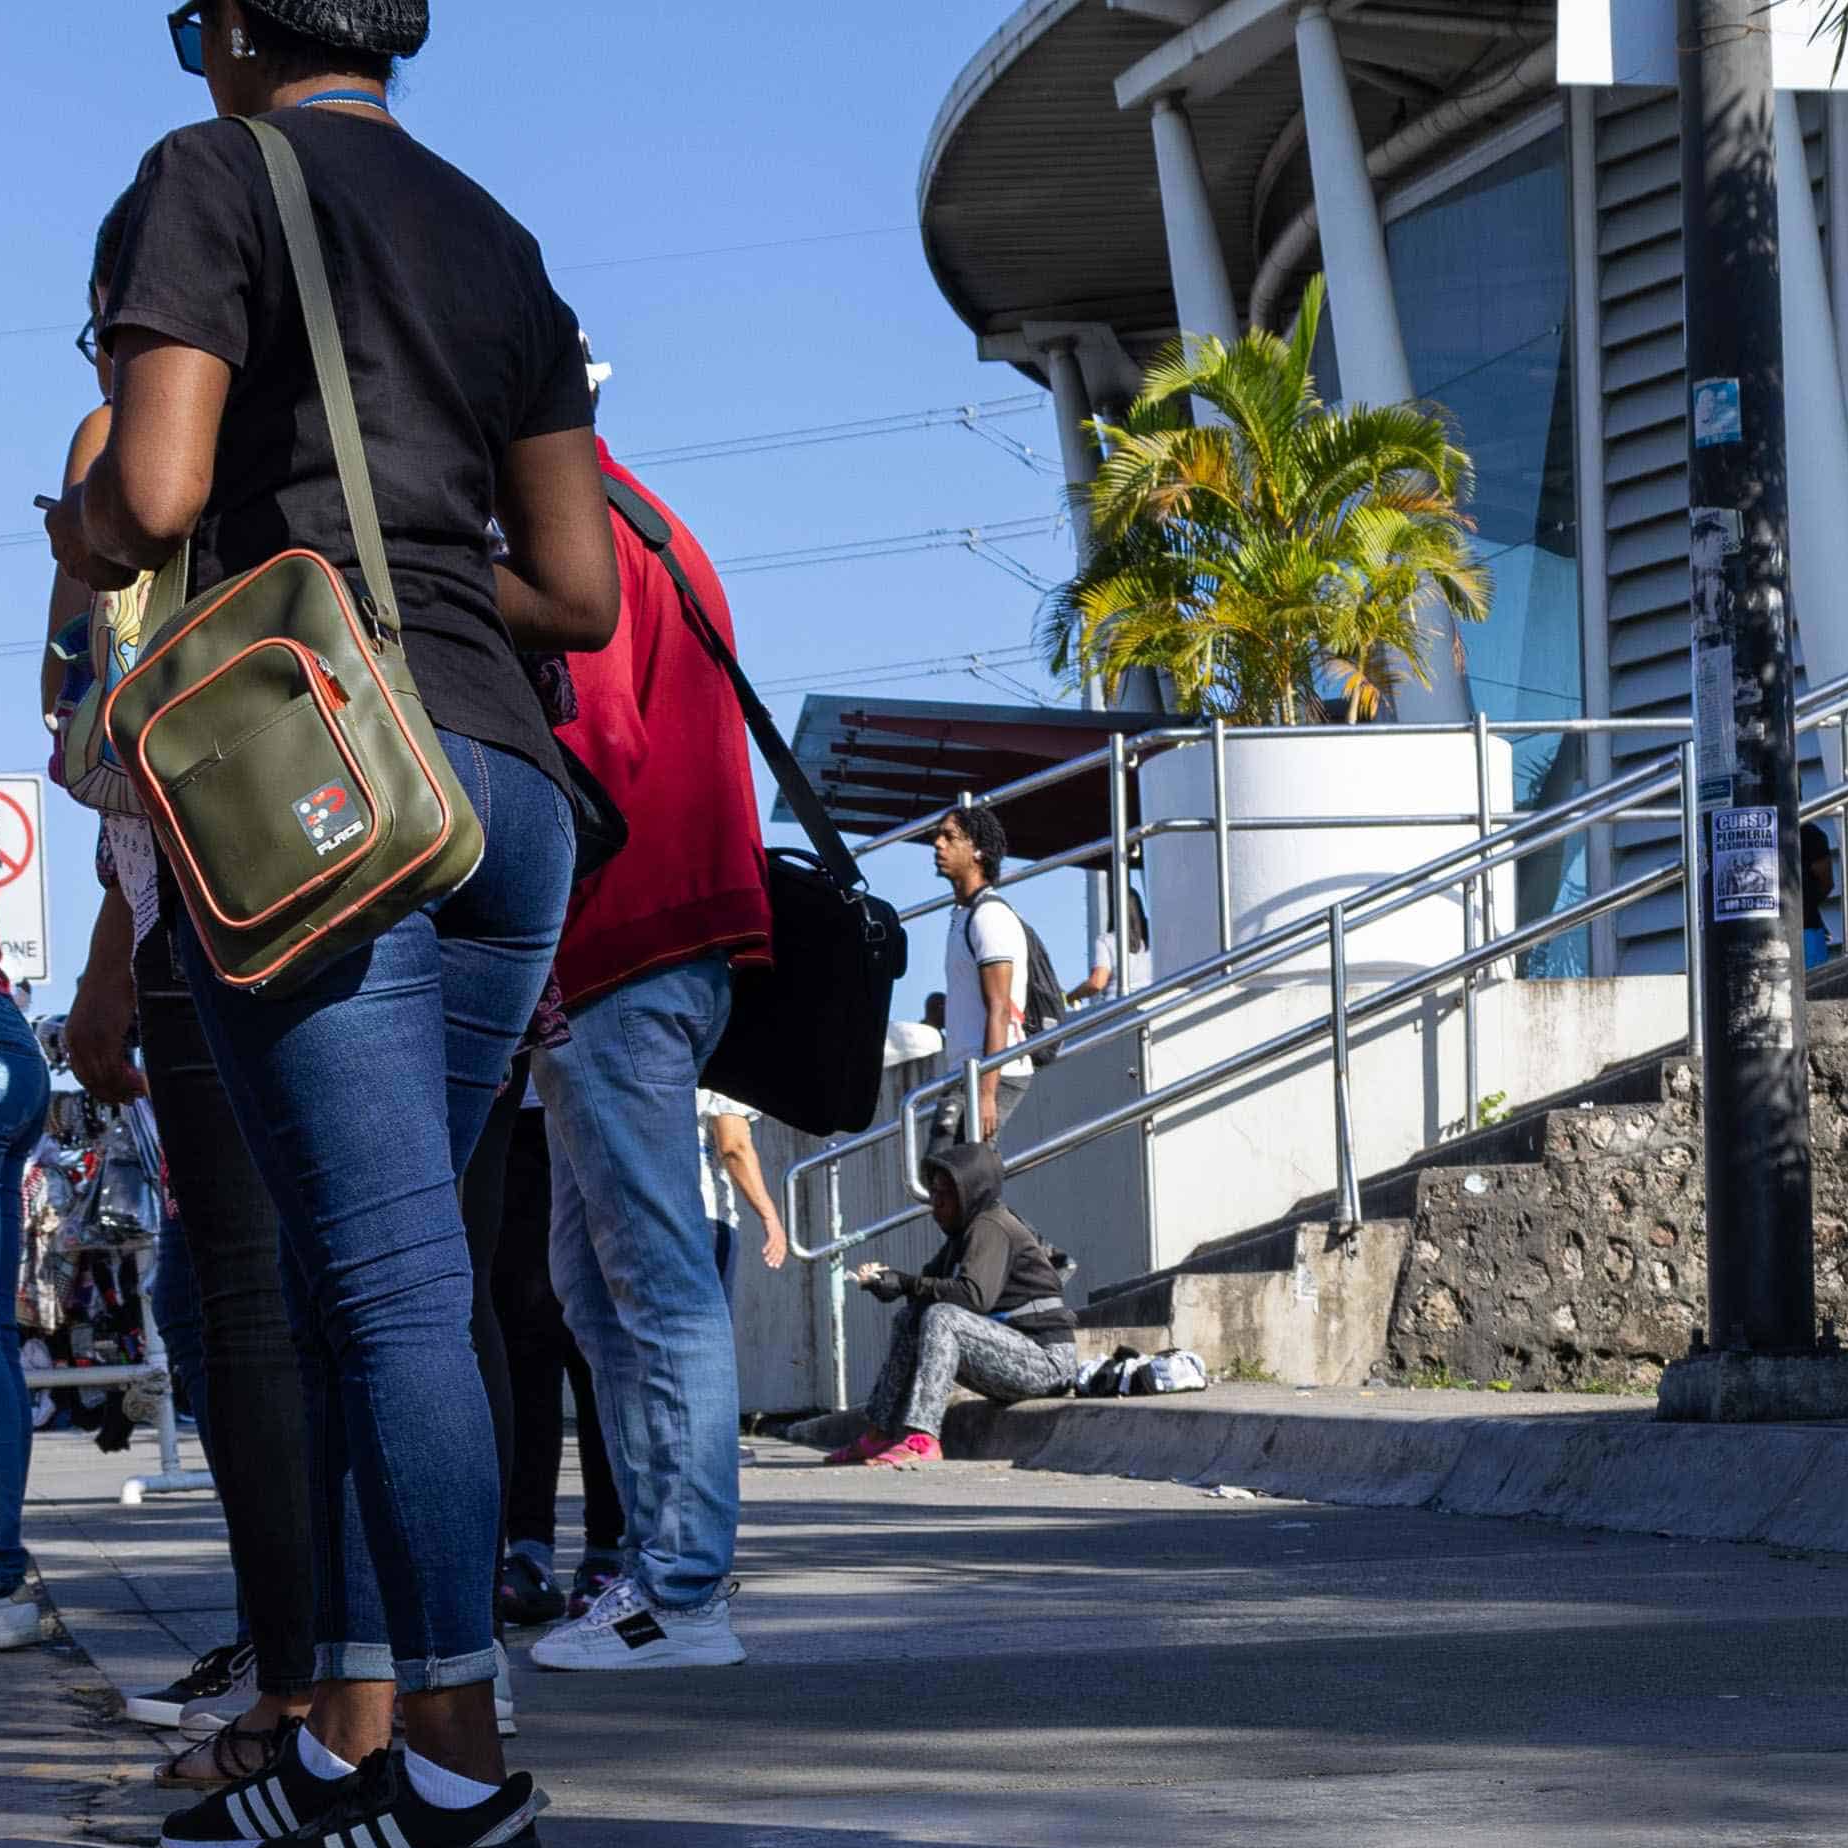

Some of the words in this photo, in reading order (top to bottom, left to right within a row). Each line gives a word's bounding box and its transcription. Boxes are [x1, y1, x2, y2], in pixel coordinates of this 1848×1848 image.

[1718, 812, 1769, 830] CURSO
[1716, 829, 1773, 843] PLOMERIA
[1717, 840, 1773, 852] RESIDENCIAL
